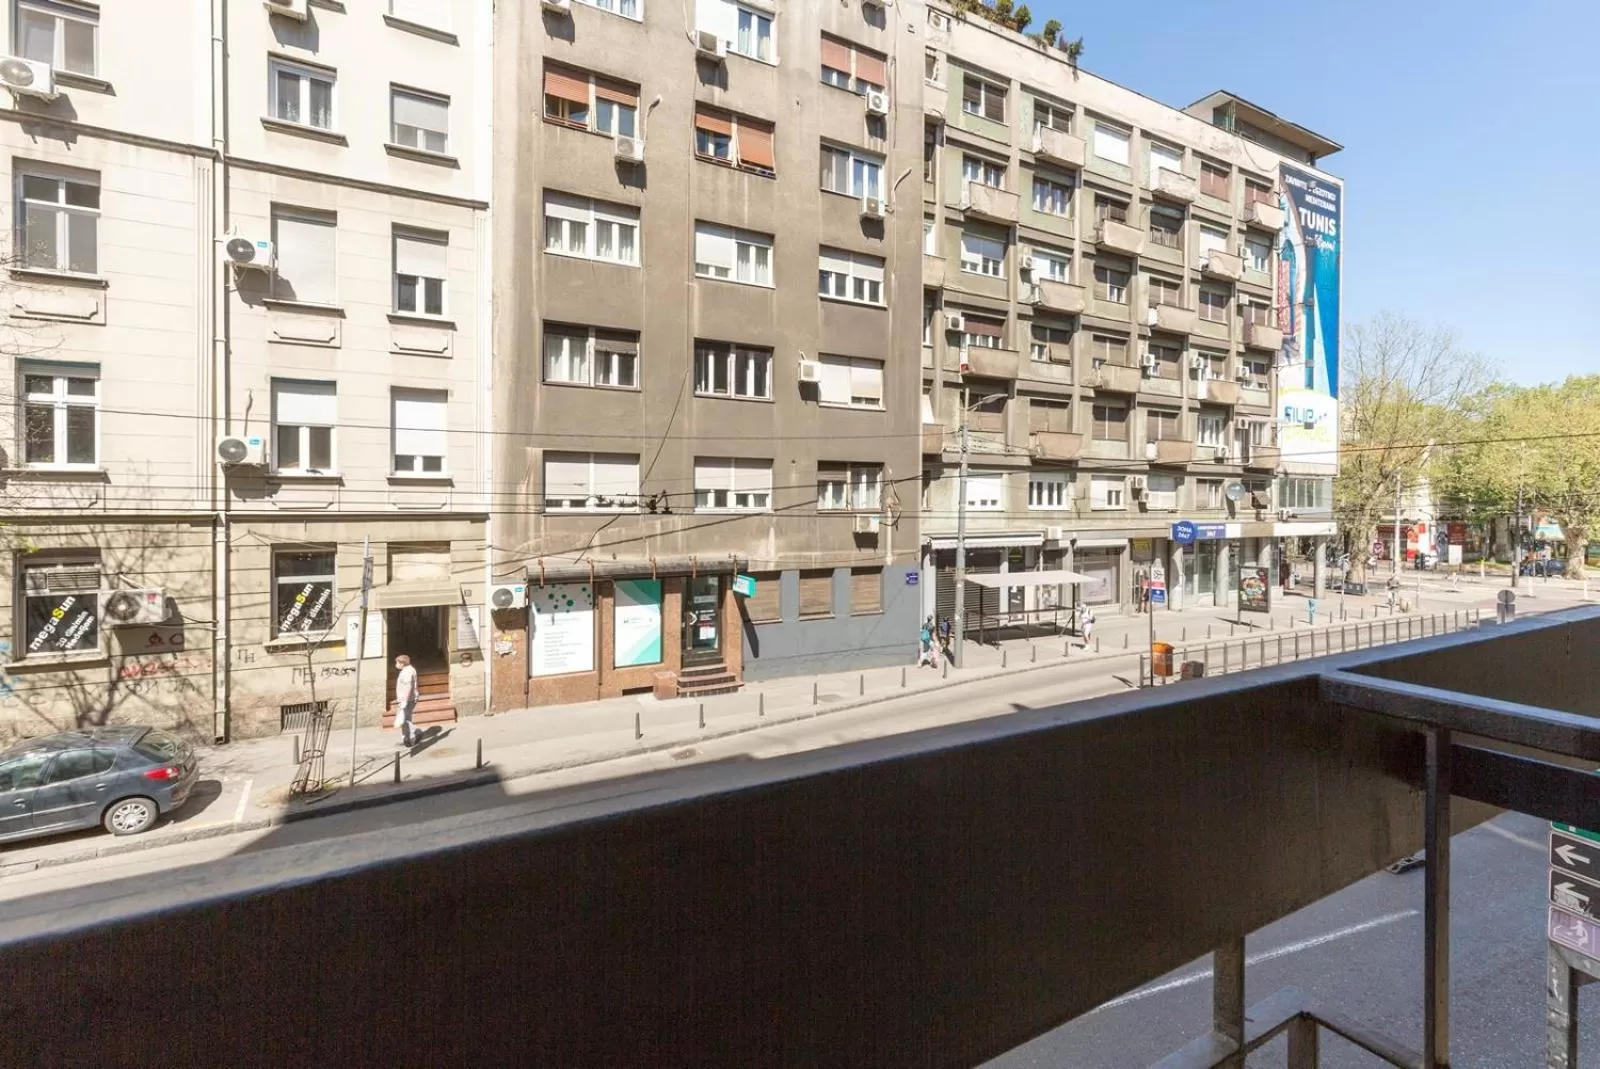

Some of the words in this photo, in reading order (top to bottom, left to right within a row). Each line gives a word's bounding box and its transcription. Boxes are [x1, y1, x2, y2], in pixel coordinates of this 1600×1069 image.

[1298, 206, 1336, 236] TUNIS
[29, 596, 76, 651] megaSun
[281, 583, 314, 631] megaSun
